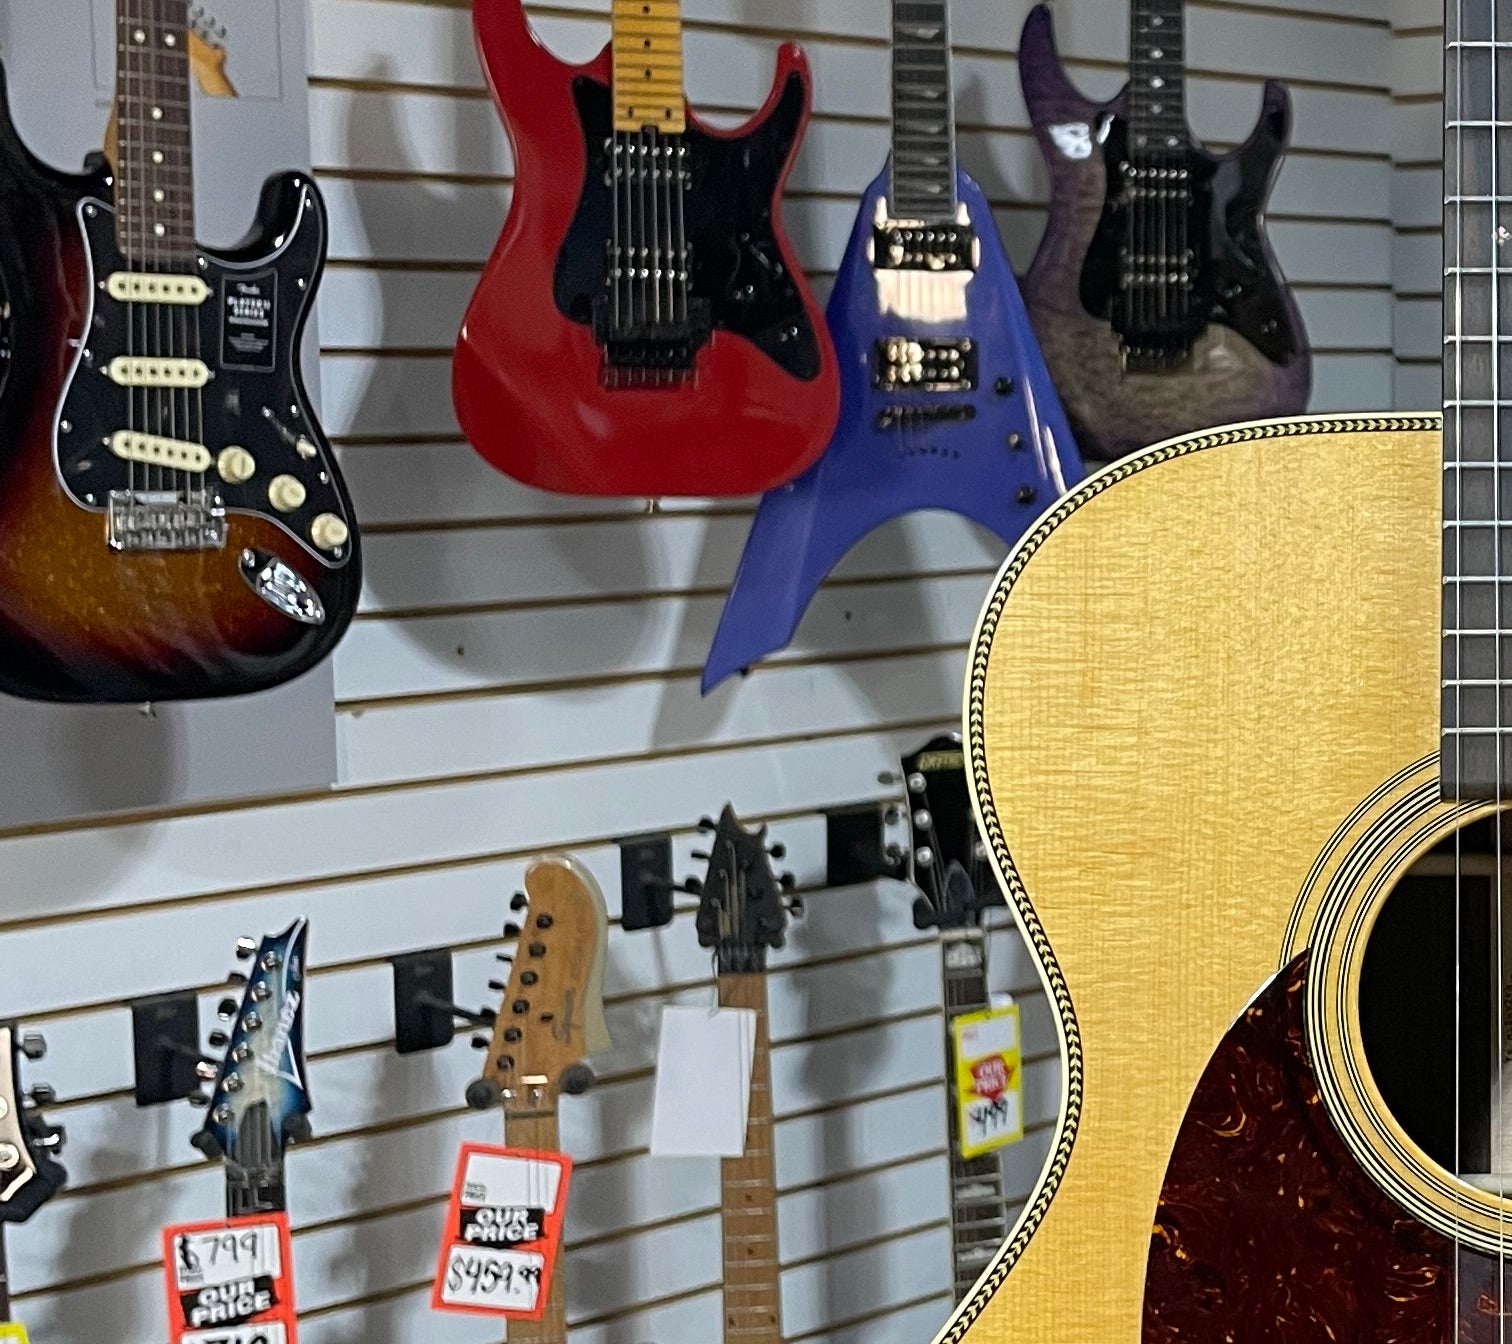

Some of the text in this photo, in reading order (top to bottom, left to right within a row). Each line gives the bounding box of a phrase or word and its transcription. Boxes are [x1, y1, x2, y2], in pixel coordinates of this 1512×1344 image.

[475, 1207, 529, 1226] OUR
[464, 1221, 540, 1242] PRICE
[198, 1279, 255, 1307] OUR
[191, 1289, 272, 1328] PRICE
